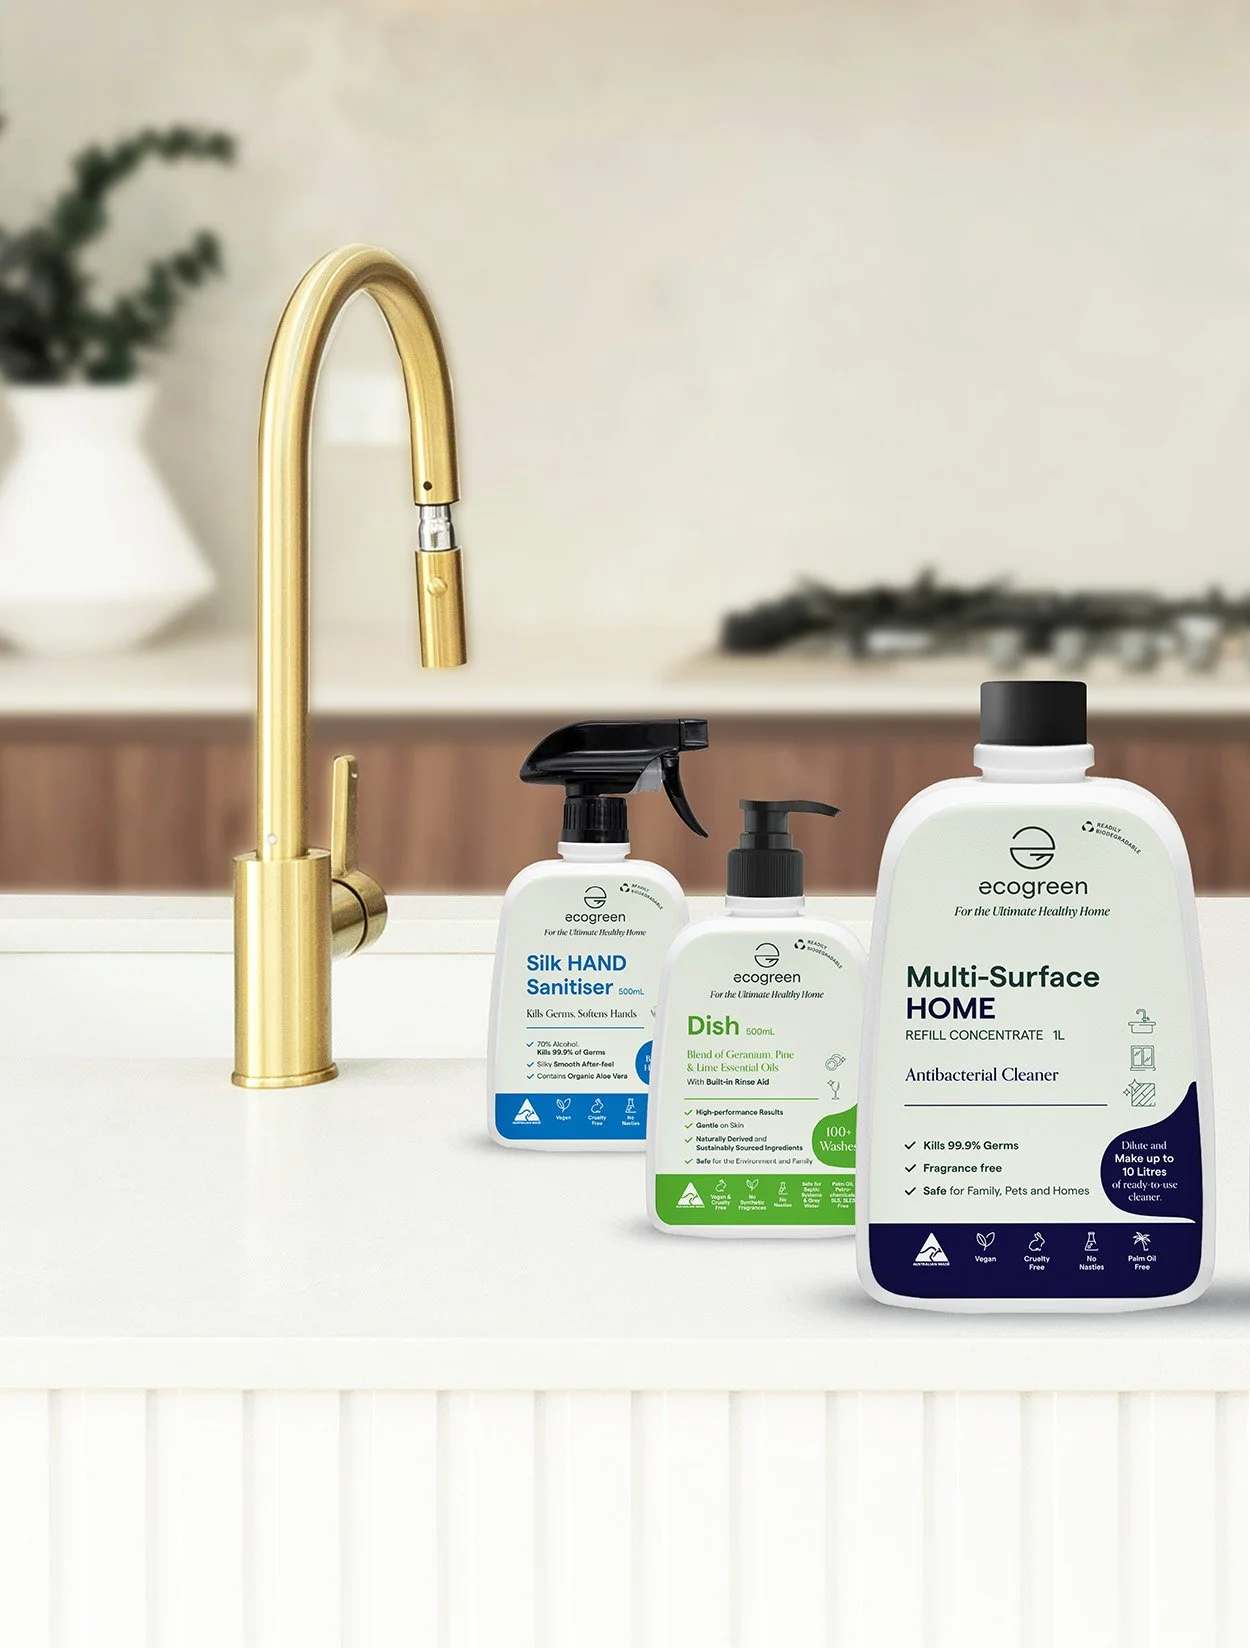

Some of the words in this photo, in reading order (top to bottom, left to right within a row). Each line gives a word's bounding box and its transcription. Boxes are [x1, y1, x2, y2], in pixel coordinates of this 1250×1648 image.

[1096, 821, 1122, 834] READILY
[1095, 828, 1142, 856] BIODEGRADABLE
[979, 881, 1088, 899] ecogreen
[955, 906, 973, 916] For
[974, 906, 991, 917] the
[993, 906, 1037, 916] Ultimate
[1038, 906, 1078, 919] Healthy
[1080, 906, 1111, 917] Home
[565, 913, 626, 924] ecogreen
[527, 954, 562, 971] Silk
[568, 955, 627, 971] HAND
[733, 973, 801, 986] ecogreen
[907, 965, 1100, 988] Multi-Surface
[527, 977, 614, 995] Sanitiser
[527, 1009, 544, 1018] Kills
[578, 1009, 608, 1018] Softens
[610, 1009, 637, 1018] Hands
[907, 997, 996, 1020] HOME
[688, 1014, 739, 1036] Dish
[746, 1028, 774, 1036] 500mL
[906, 1029, 947, 1041] REFILL
[949, 1029, 1043, 1041] CONCENTRATE
[1053, 1030, 1065, 1040] 1L
[687, 1063, 694, 1072] &
[697, 1063, 719, 1072] Lime
[721, 1063, 759, 1072] Essential
[761, 1063, 779, 1072] Oils
[567, 1073, 595, 1081] Organic
[905, 1067, 997, 1082] Antibacterial
[1002, 1067, 1059, 1082] Cleaner
[687, 1078, 705, 1086] With
[706, 1078, 733, 1086] Built-in
[735, 1078, 756, 1086] Rinse
[757, 1078, 770, 1086] Aid
[826, 1126, 851, 1137] 100+
[924, 1141, 945, 1151] Kills
[948, 1141, 981, 1150] 99.9%
[983, 1141, 1019, 1150] Germs
[1122, 1141, 1148, 1150] Dilute
[1150, 1140, 1167, 1150] and
[1115, 1153, 1144, 1163] Make
[1146, 1155, 1160, 1165] up
[1163, 1154, 1174, 1163] to
[923, 1163, 978, 1175] Fragrance
[980, 1163, 1002, 1173] free
[1122, 1167, 1135, 1177] 10
[1137, 1166, 1167, 1177] Litres
[1112, 1179, 1122, 1189] of
[923, 1186, 947, 1196] Safe
[949, 1185, 965, 1196] for
[967, 1186, 1002, 1197] Family,
[1005, 1186, 1028, 1196] Pets
[1030, 1186, 1050, 1196] and
[1053, 1186, 1090, 1196] Homes
[1128, 1192, 1162, 1202] cleaner.
[974, 1255, 997, 1264] Vegan
[1024, 1255, 1050, 1263] Cruelty
[1079, 1263, 1105, 1271] Nasties
[1135, 1263, 1151, 1271] Free
